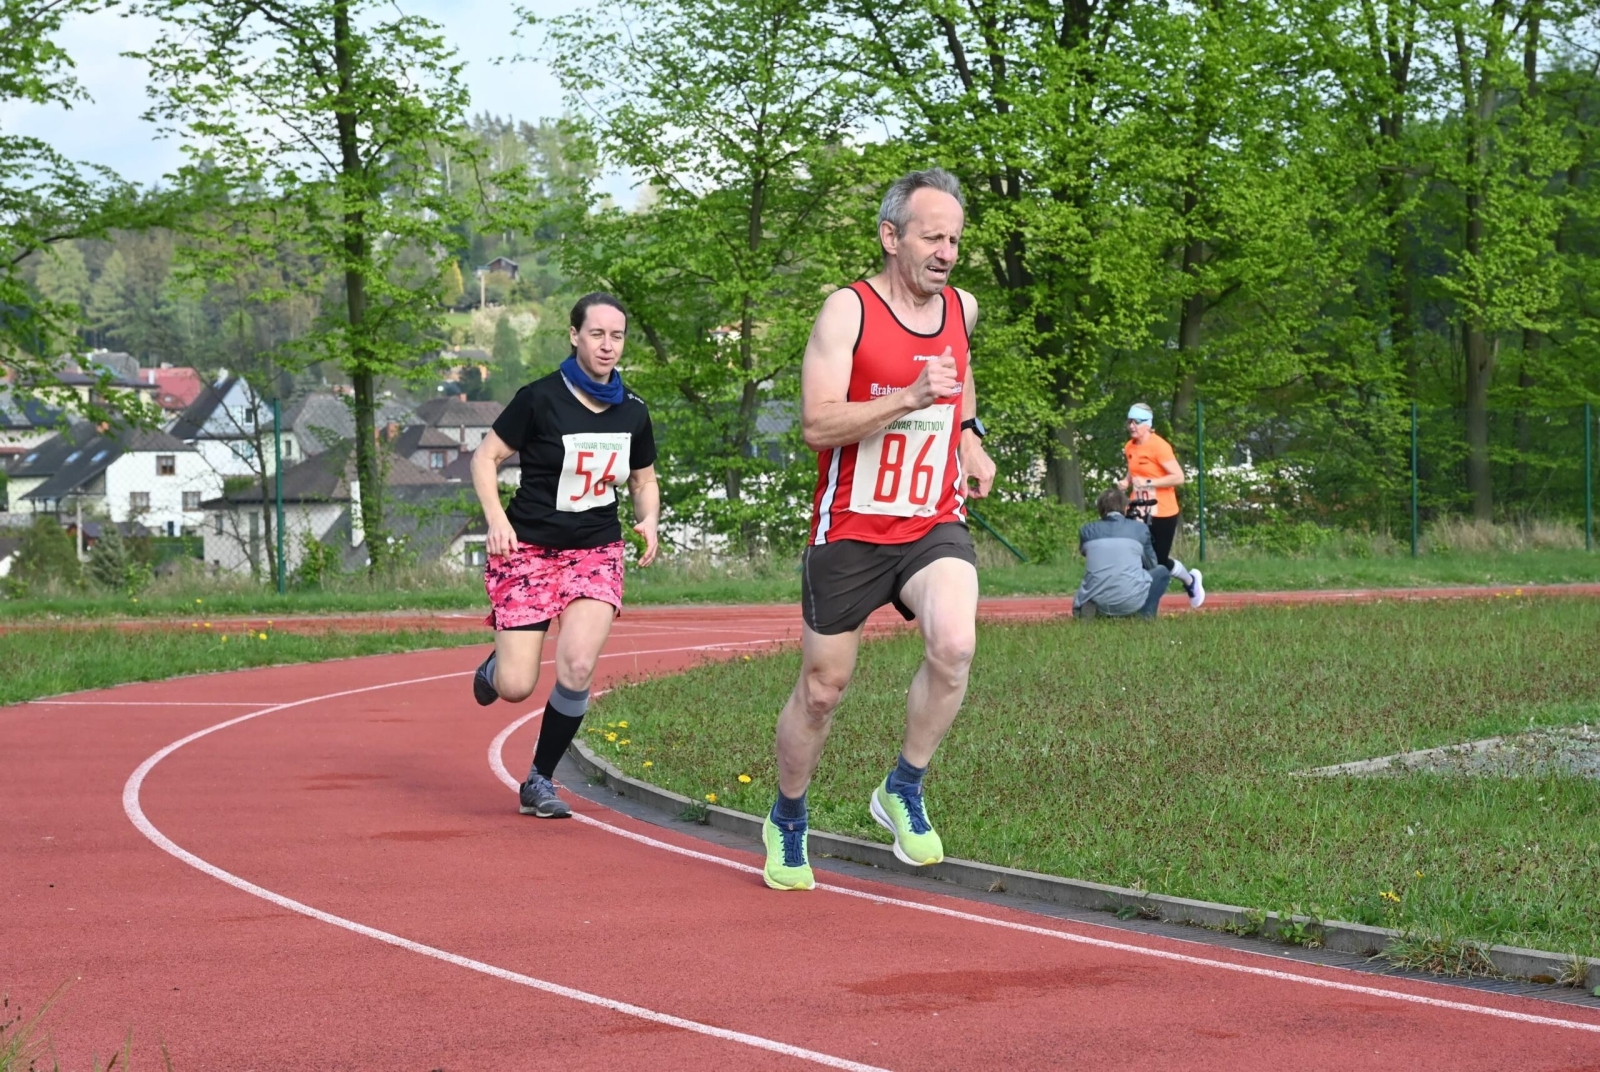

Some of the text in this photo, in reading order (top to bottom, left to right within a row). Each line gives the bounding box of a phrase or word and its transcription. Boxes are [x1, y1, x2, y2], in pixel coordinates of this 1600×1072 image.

[914, 420, 945, 432] TRUTNOV
[599, 442, 623, 451] TRUTNOV
[569, 451, 617, 502] 56
[873, 433, 936, 505] 86
